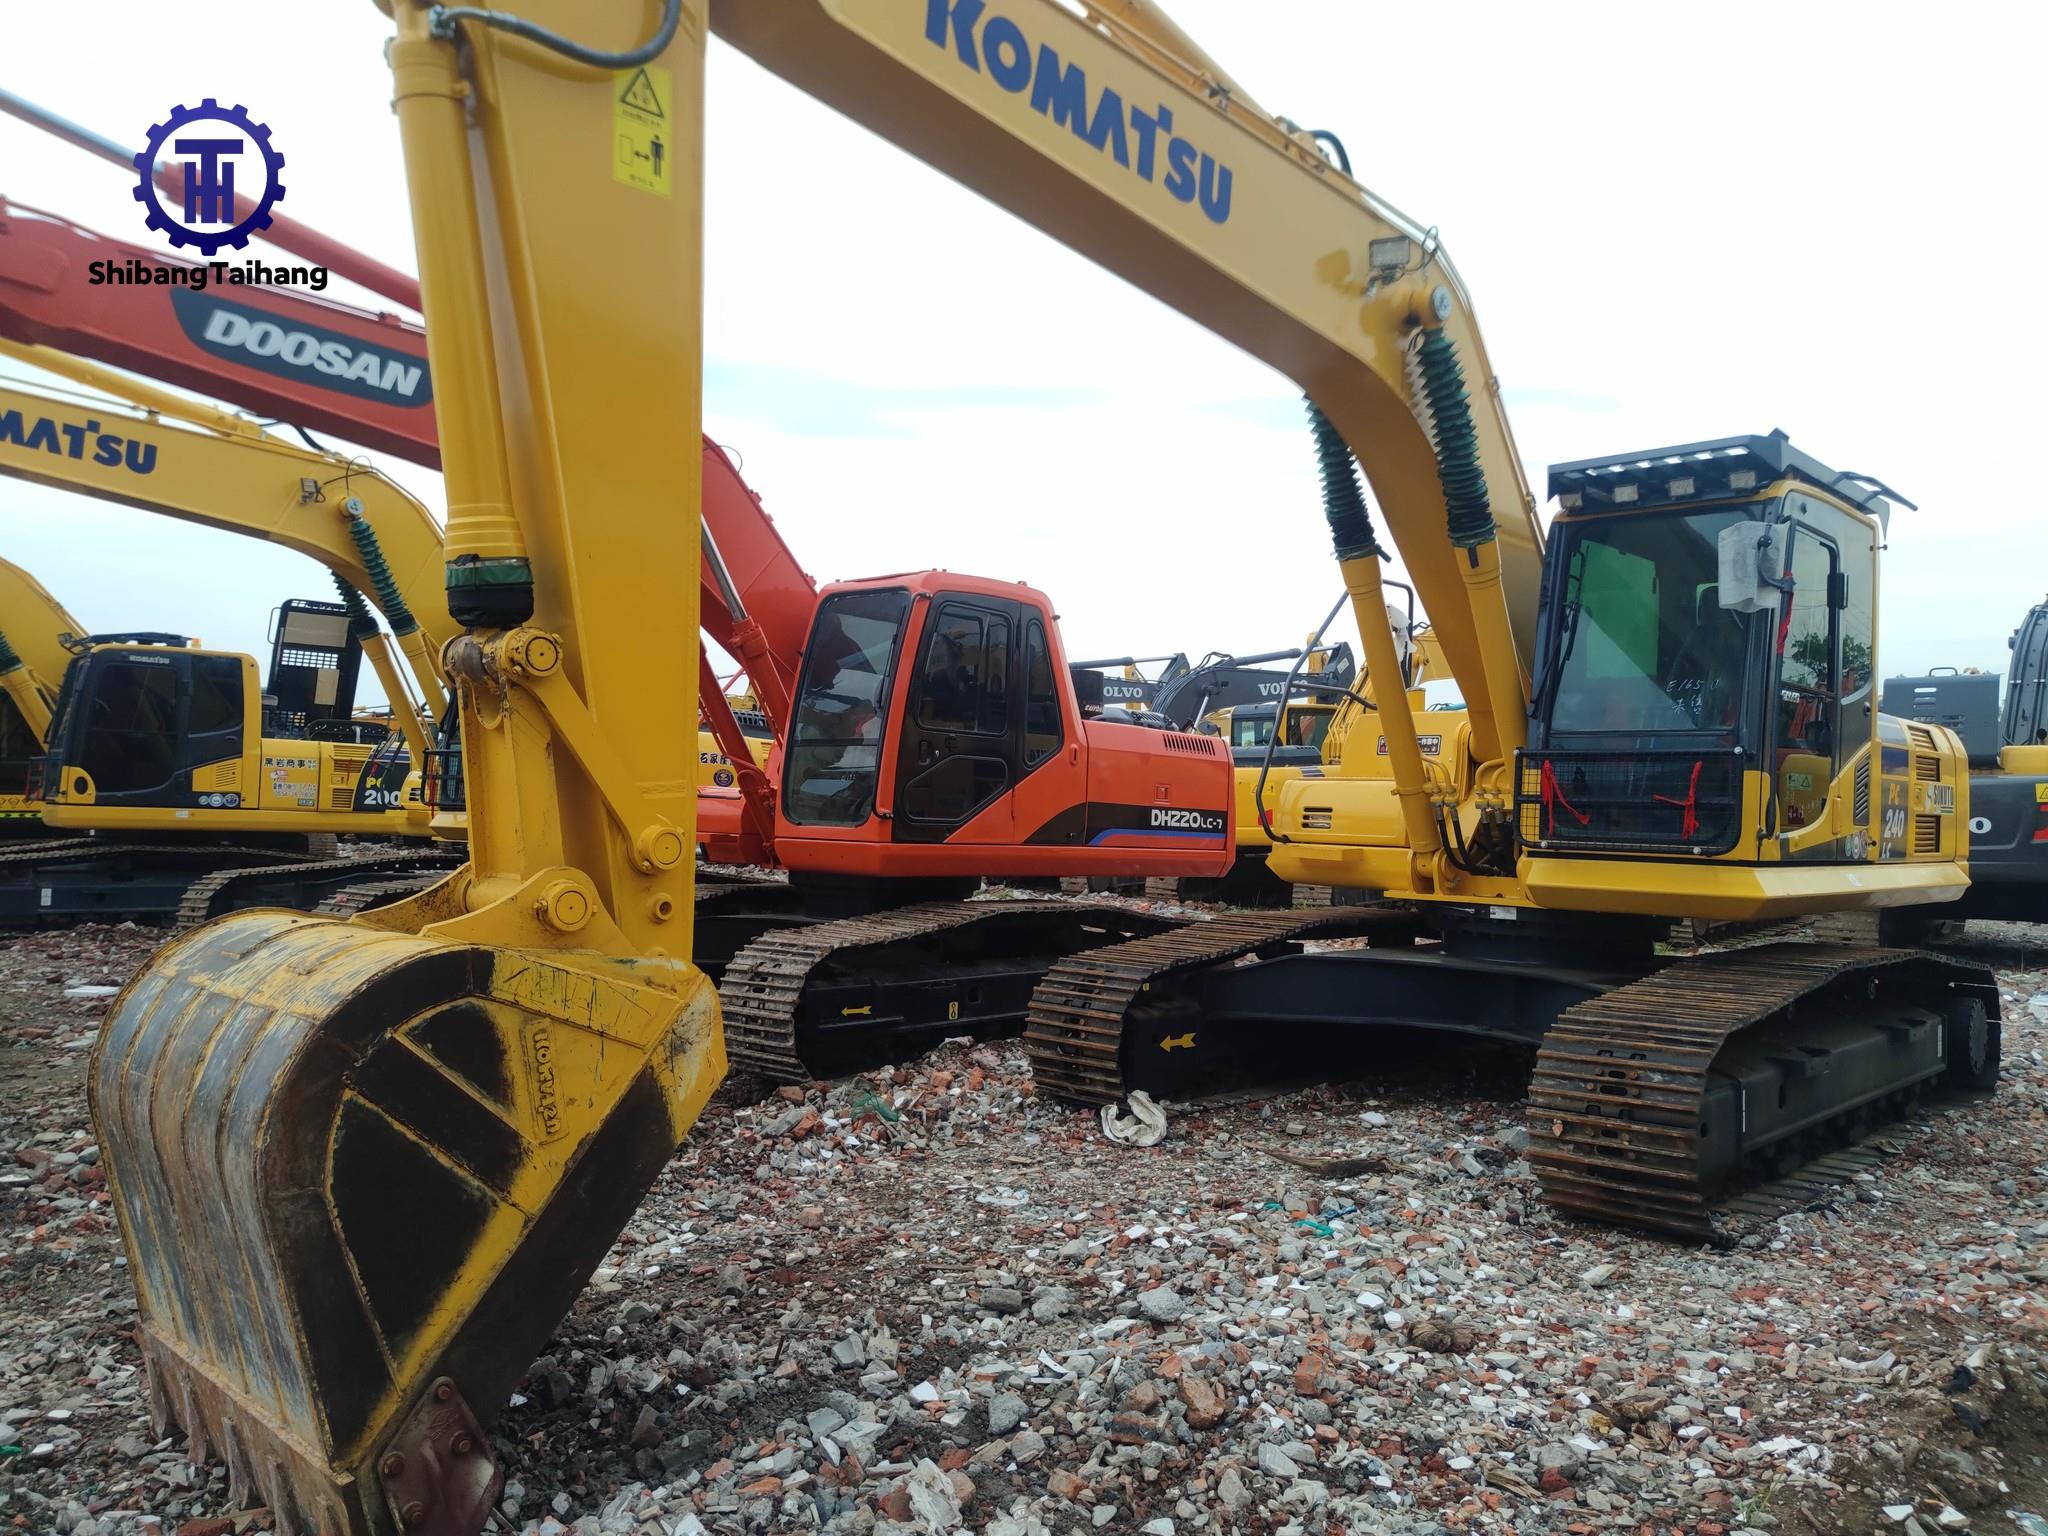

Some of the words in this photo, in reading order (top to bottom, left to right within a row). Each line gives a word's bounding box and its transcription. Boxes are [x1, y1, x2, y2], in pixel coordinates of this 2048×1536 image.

[925, 0, 1232, 224] KOMATSU
[204, 309, 422, 397] DOOSAN
[1884, 809, 1905, 838] 240
